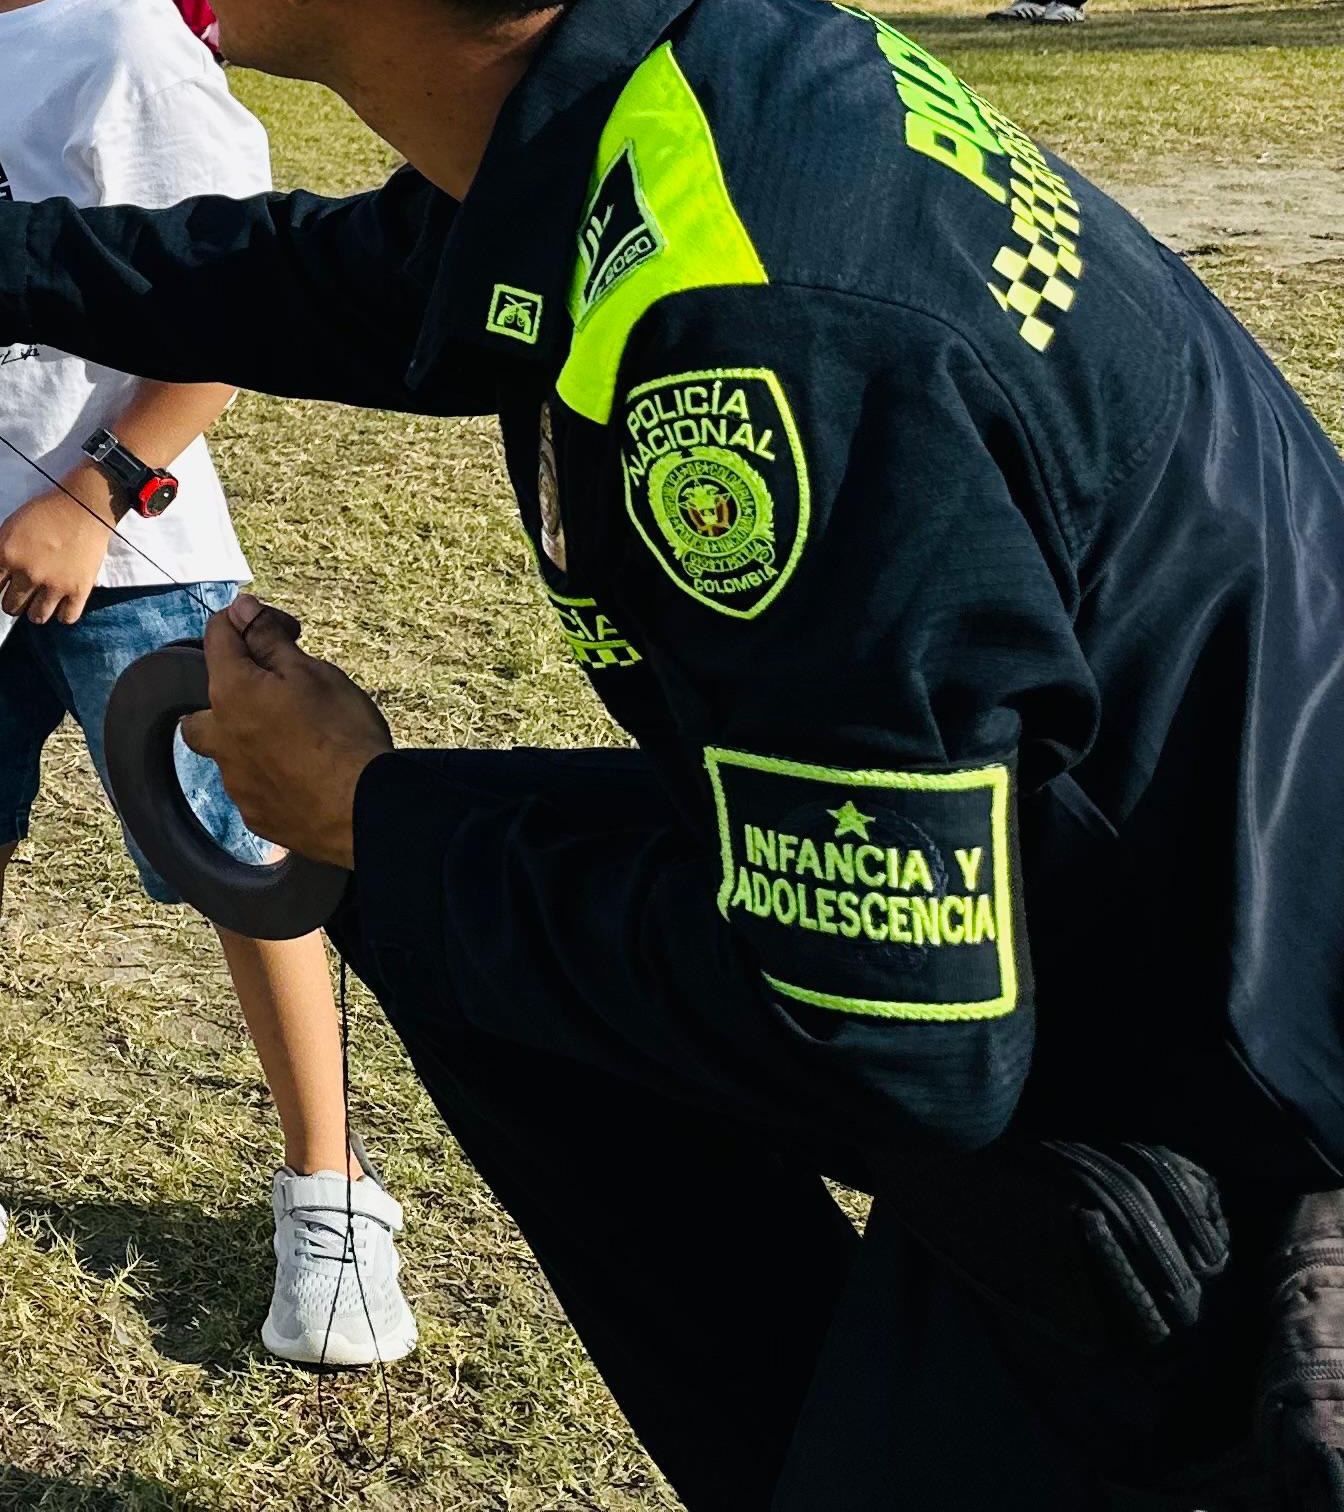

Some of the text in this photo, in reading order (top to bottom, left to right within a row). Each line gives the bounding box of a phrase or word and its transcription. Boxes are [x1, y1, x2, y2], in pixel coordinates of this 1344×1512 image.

[627, 380, 750, 440] POLICÍA
[628, 418, 776, 487] NACIONAL
[694, 564, 779, 593] COLOMBIA
[743, 824, 983, 891] INFANCIA Y
[730, 866, 997, 946] ADOLESCENCIA
